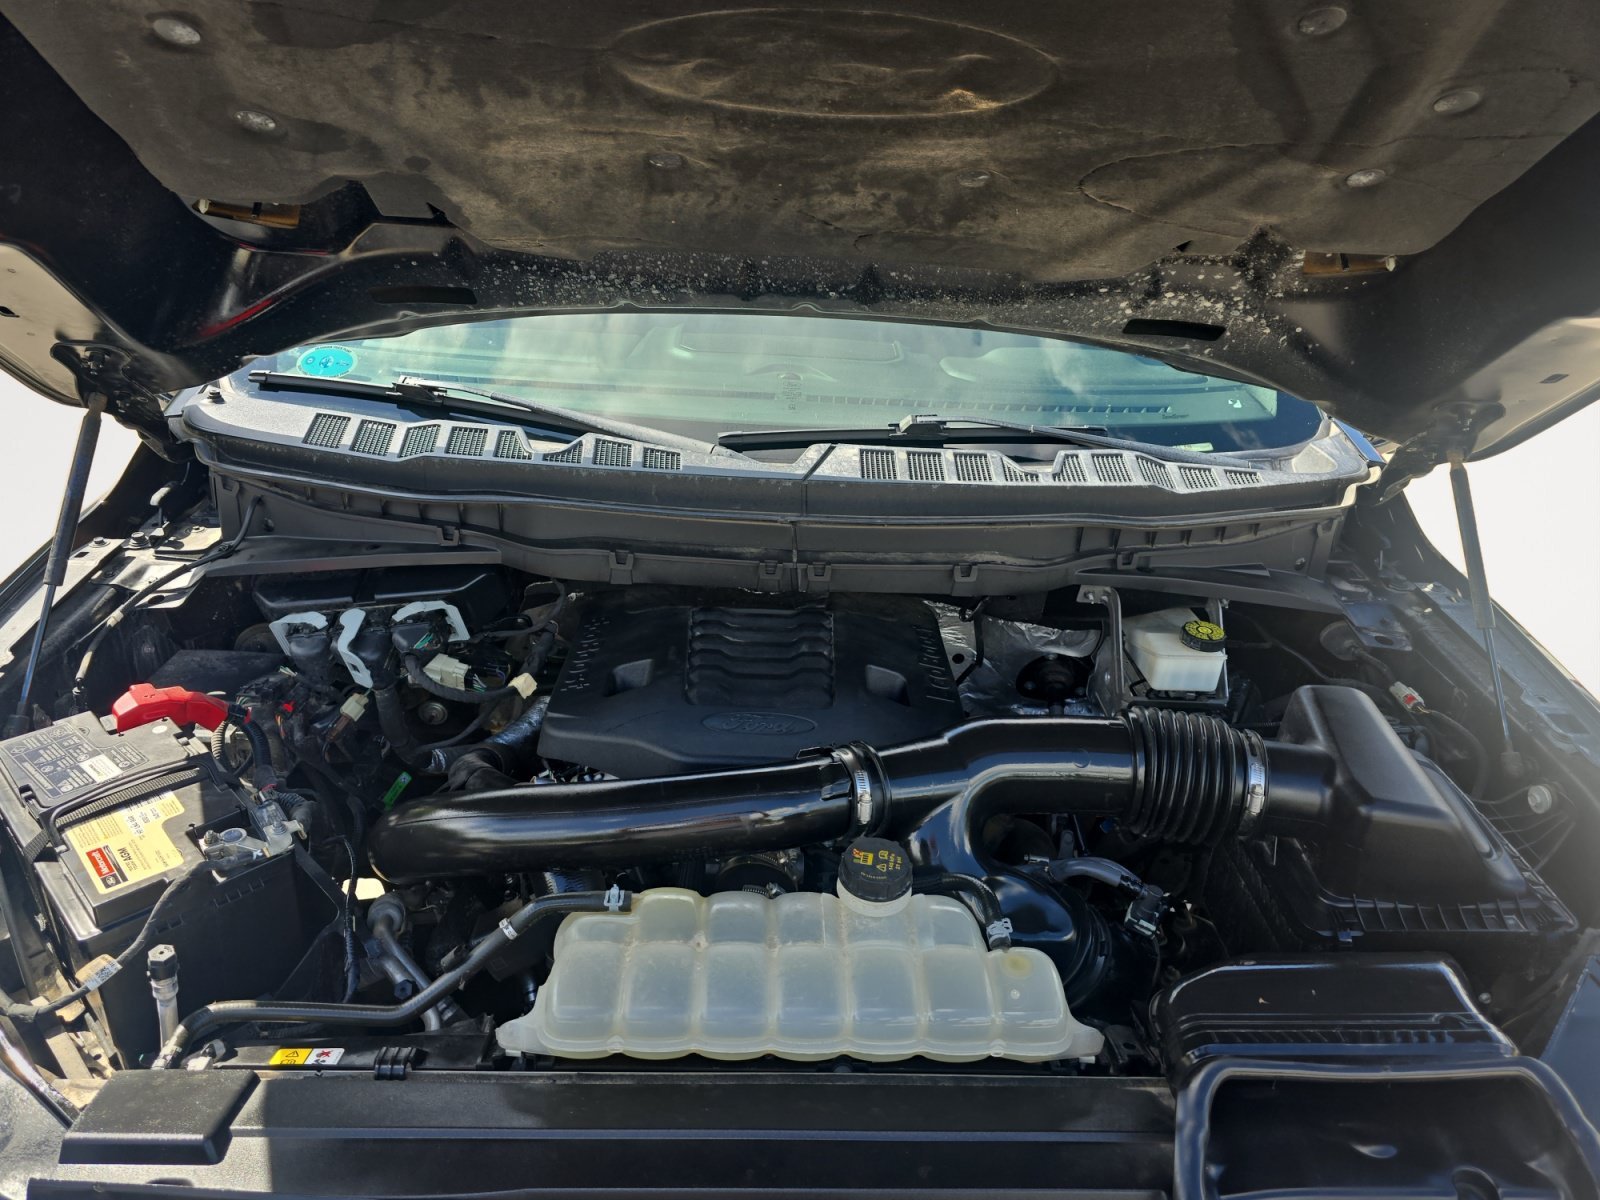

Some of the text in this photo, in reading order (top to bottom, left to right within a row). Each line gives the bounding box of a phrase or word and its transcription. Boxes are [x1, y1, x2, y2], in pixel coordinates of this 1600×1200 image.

[721, 711, 796, 734] Ford
[91, 850, 110, 875] Motorcraft
[117, 847, 132, 862] AGM
